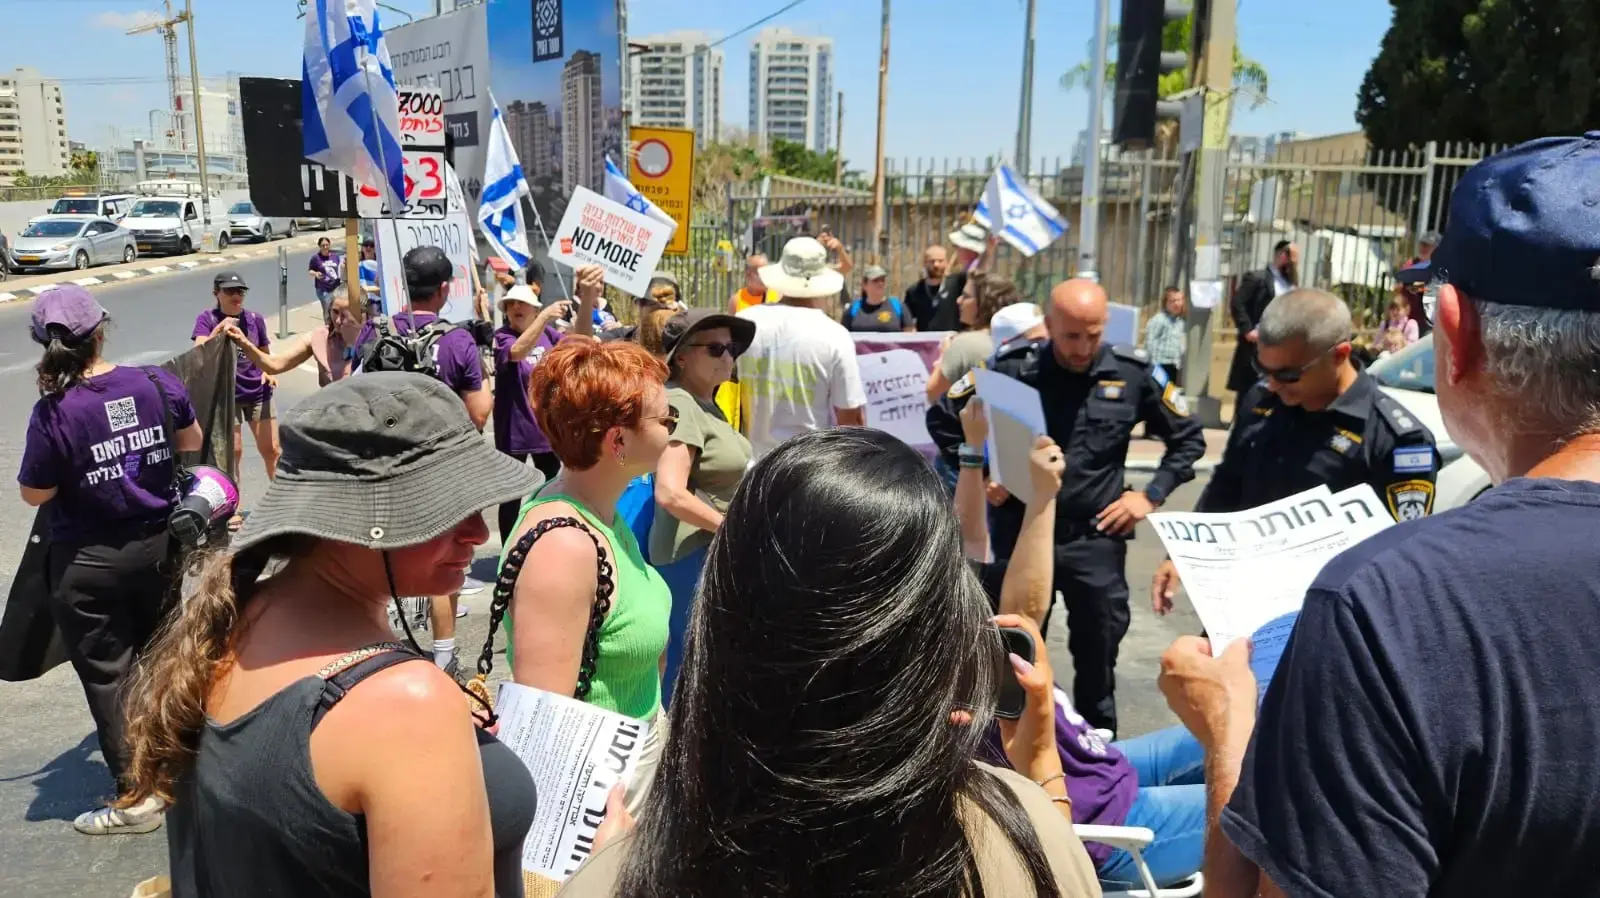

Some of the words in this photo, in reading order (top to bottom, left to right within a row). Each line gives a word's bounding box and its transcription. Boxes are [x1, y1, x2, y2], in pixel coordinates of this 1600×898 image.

[402, 46, 431, 67] המגורים
[432, 40, 451, 60] רובע
[571, 226, 595, 251] NO
[595, 238, 643, 273] MORE
[90, 436, 127, 463] האם
[127, 425, 166, 451] בשם
[1240, 498, 1332, 538] הותר
[1160, 521, 1236, 544] דמנו!
